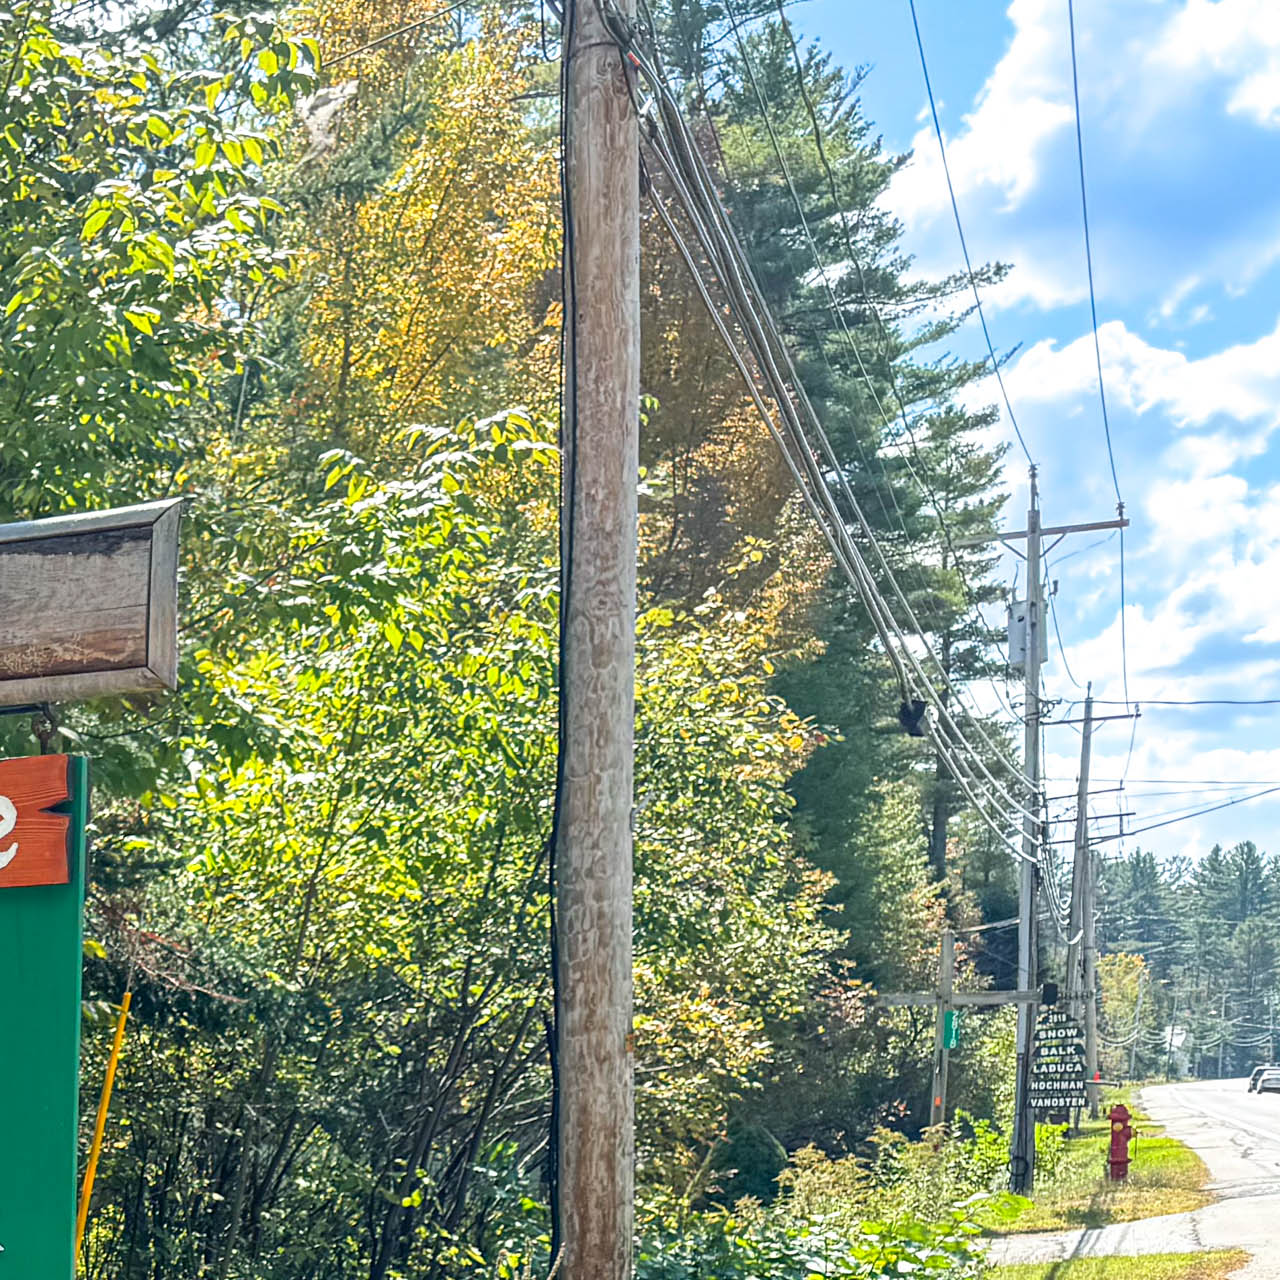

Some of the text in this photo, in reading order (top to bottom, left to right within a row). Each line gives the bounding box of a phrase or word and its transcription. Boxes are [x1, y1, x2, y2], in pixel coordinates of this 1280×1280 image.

[1039, 1029, 1078, 1039] SNOW
[1040, 1046, 1076, 1056] BALK
[1033, 1063, 1083, 1073] LADUCA
[1031, 1080, 1083, 1090] HOCHMAN
